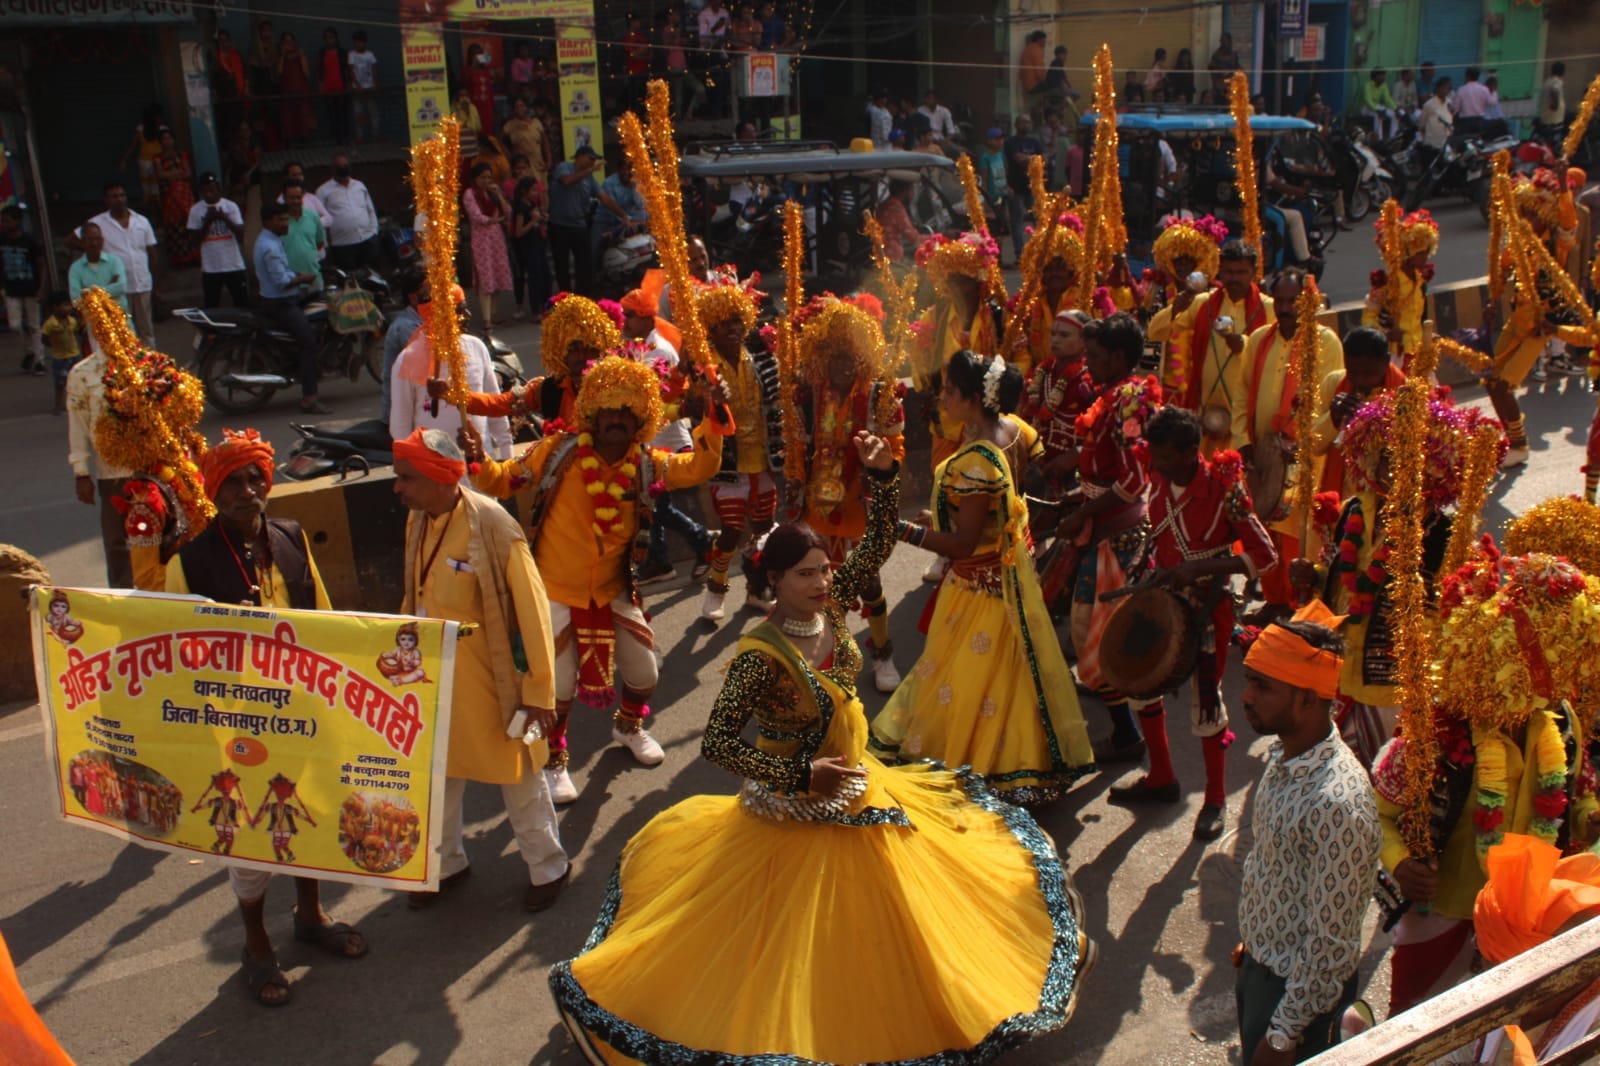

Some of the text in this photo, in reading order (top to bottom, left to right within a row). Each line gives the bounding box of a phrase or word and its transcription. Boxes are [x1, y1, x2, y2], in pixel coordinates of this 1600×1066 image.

[560, 39, 593, 48] HAPPY
[406, 45, 441, 54] HAPPY
[560, 49, 593, 58] DIWALI
[407, 55, 442, 64] DIWALI
[59, 621, 424, 758] अहिर नृत्य कला परिषद बराही
[194, 679, 291, 709] थाना-तखतपुर
[162, 699, 317, 738] जिला-बिलासपुर (छ.ग.)
[387, 769, 410, 779] यादव
[354, 778, 410, 791] 9171144709
